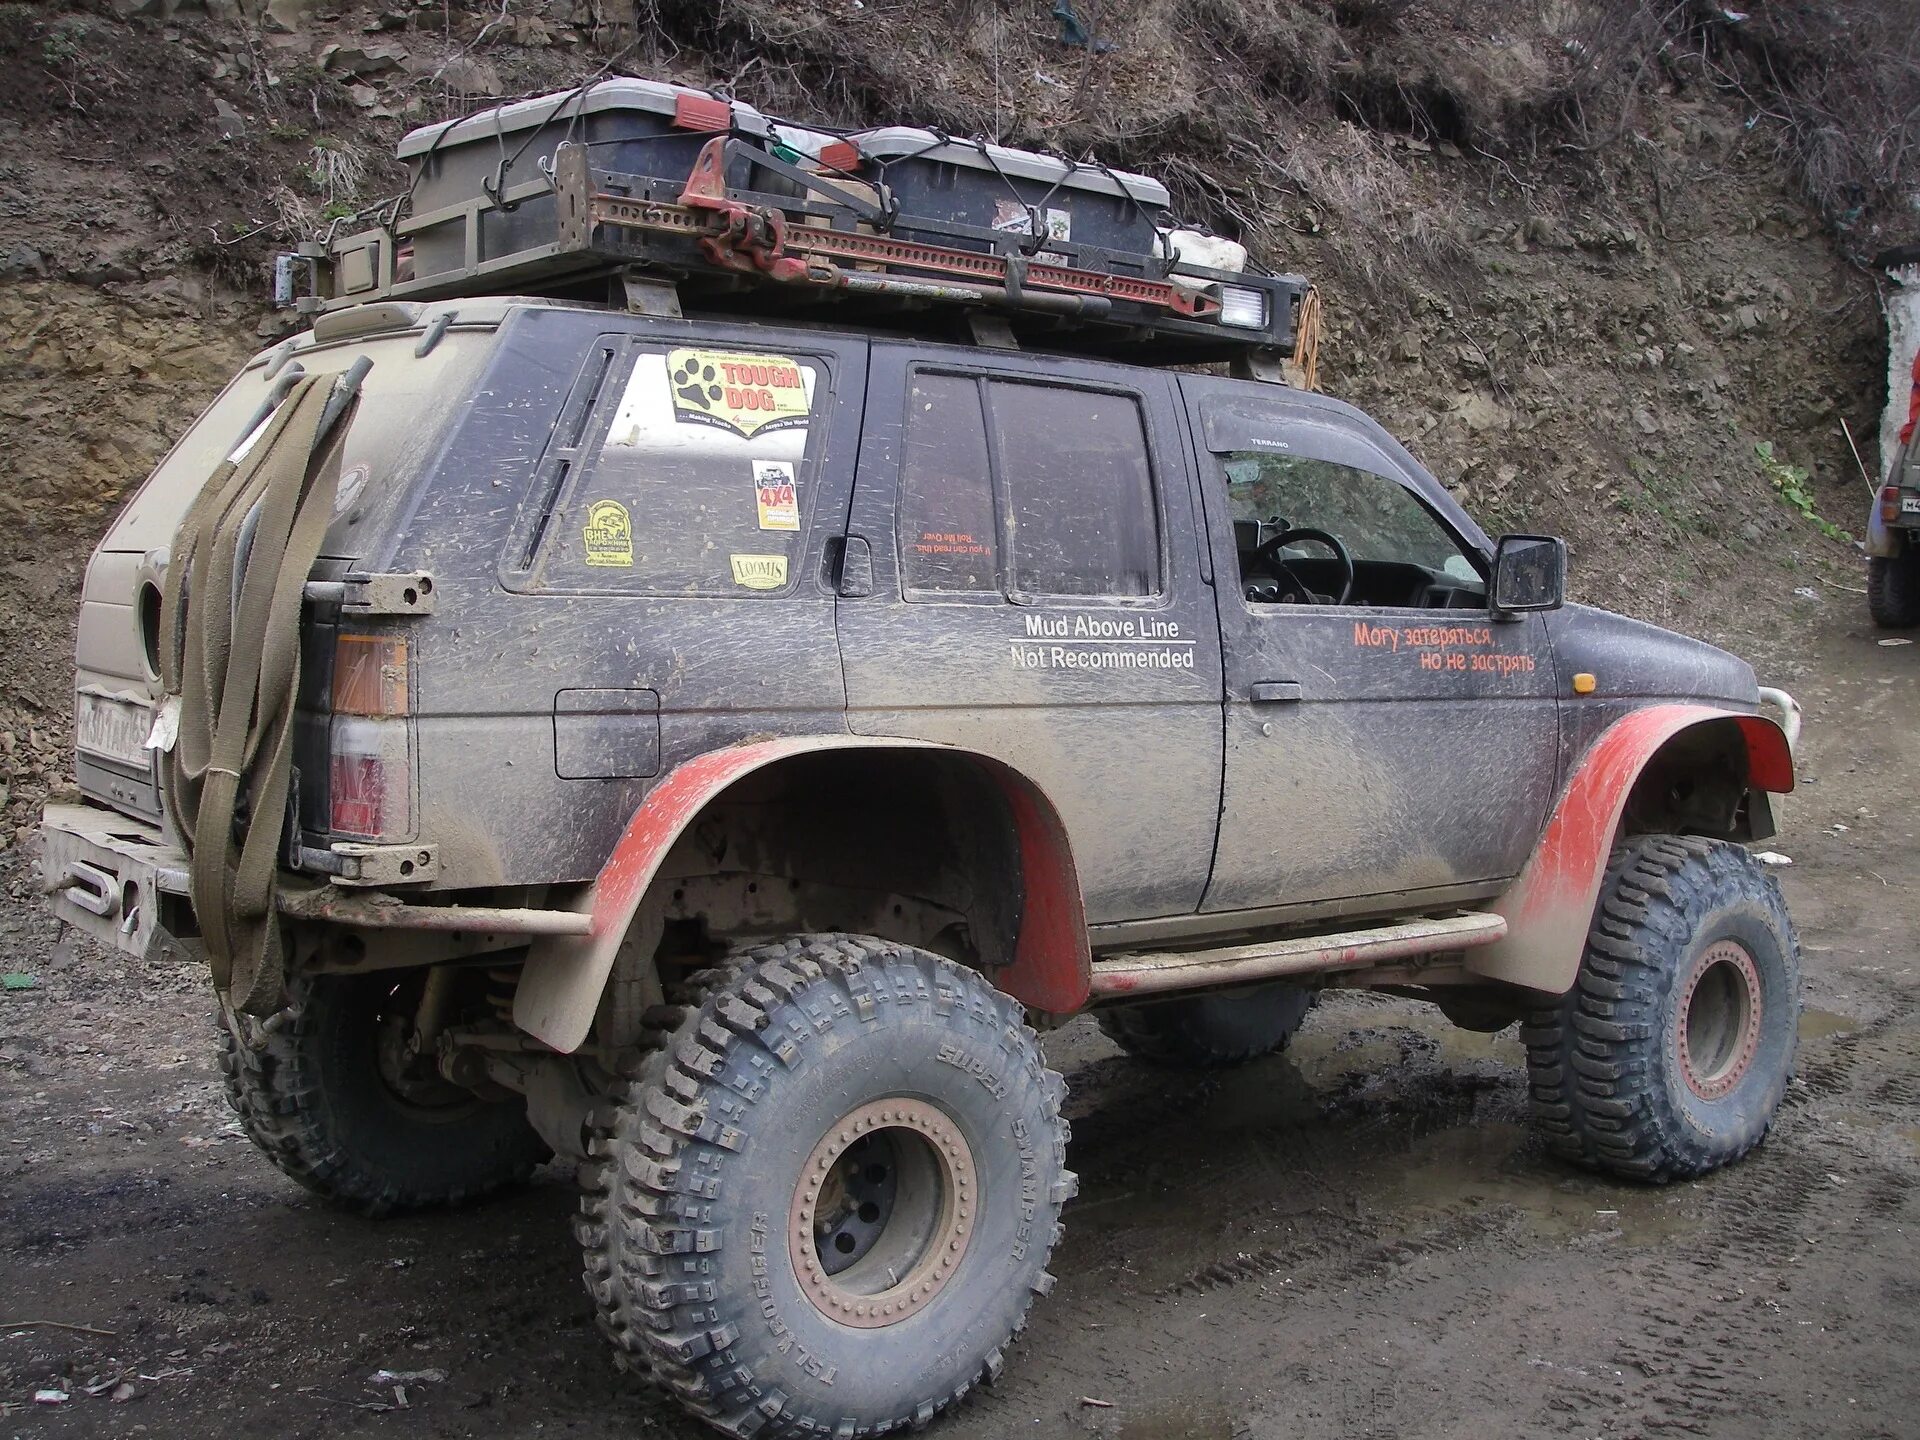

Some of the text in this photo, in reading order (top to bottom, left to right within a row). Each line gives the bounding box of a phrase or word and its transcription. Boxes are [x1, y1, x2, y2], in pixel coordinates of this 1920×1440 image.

[720, 362, 801, 389] TOUGH
[724, 387, 776, 411] DOG
[1250, 438, 1289, 449] TERRANO
[736, 560, 783, 579] LOOMIS
[1025, 614, 1180, 638] Mud Above Line
[1354, 622, 1496, 652] Могу затеряться,
[1010, 646, 1194, 668] Not Recommended
[1421, 653, 1536, 678] но не застрять
[936, 1043, 1036, 1262] SUPER SWAMPER
[751, 1210, 840, 1387] TSL BOGGER
